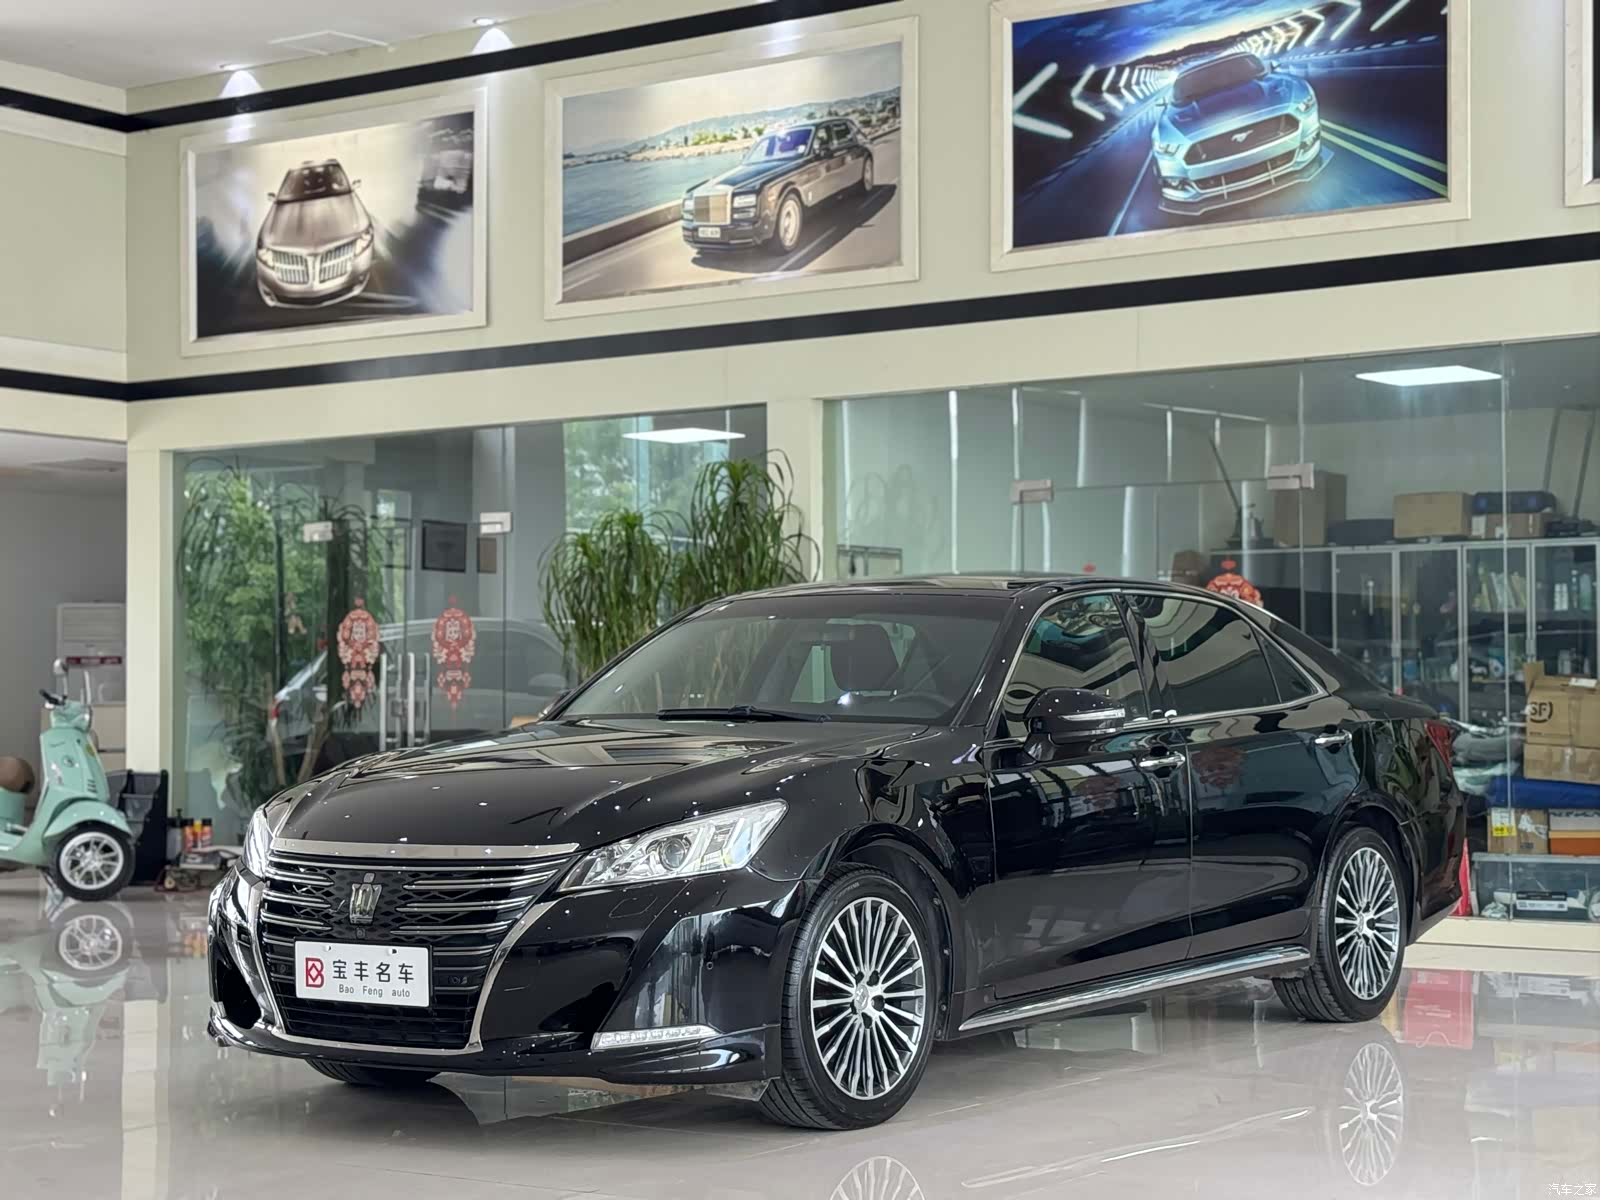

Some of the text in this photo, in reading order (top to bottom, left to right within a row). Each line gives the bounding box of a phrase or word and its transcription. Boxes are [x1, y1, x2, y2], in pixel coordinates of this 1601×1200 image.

[1530, 701, 1548, 717] SF
[332, 959, 414, 984] 宝丰名车
[338, 983, 411, 998] Bao Feng auto
